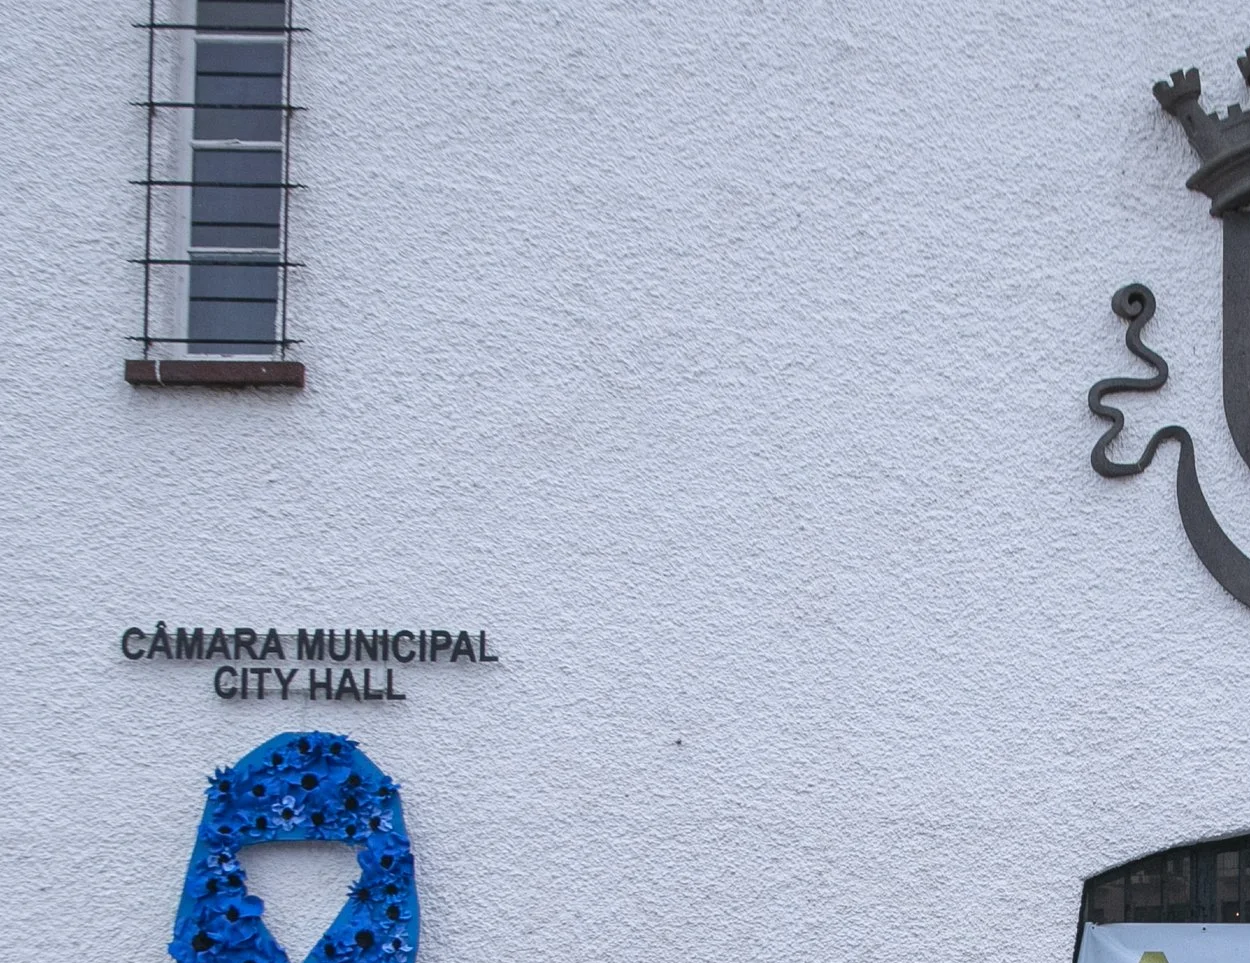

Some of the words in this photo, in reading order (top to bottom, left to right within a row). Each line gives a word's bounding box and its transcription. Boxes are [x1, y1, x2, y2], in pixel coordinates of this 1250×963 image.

[121, 620, 286, 661] CÂMARA
[297, 627, 499, 663] MUNICIPAL
[213, 665, 299, 700] CITY
[308, 667, 407, 701] HALL
